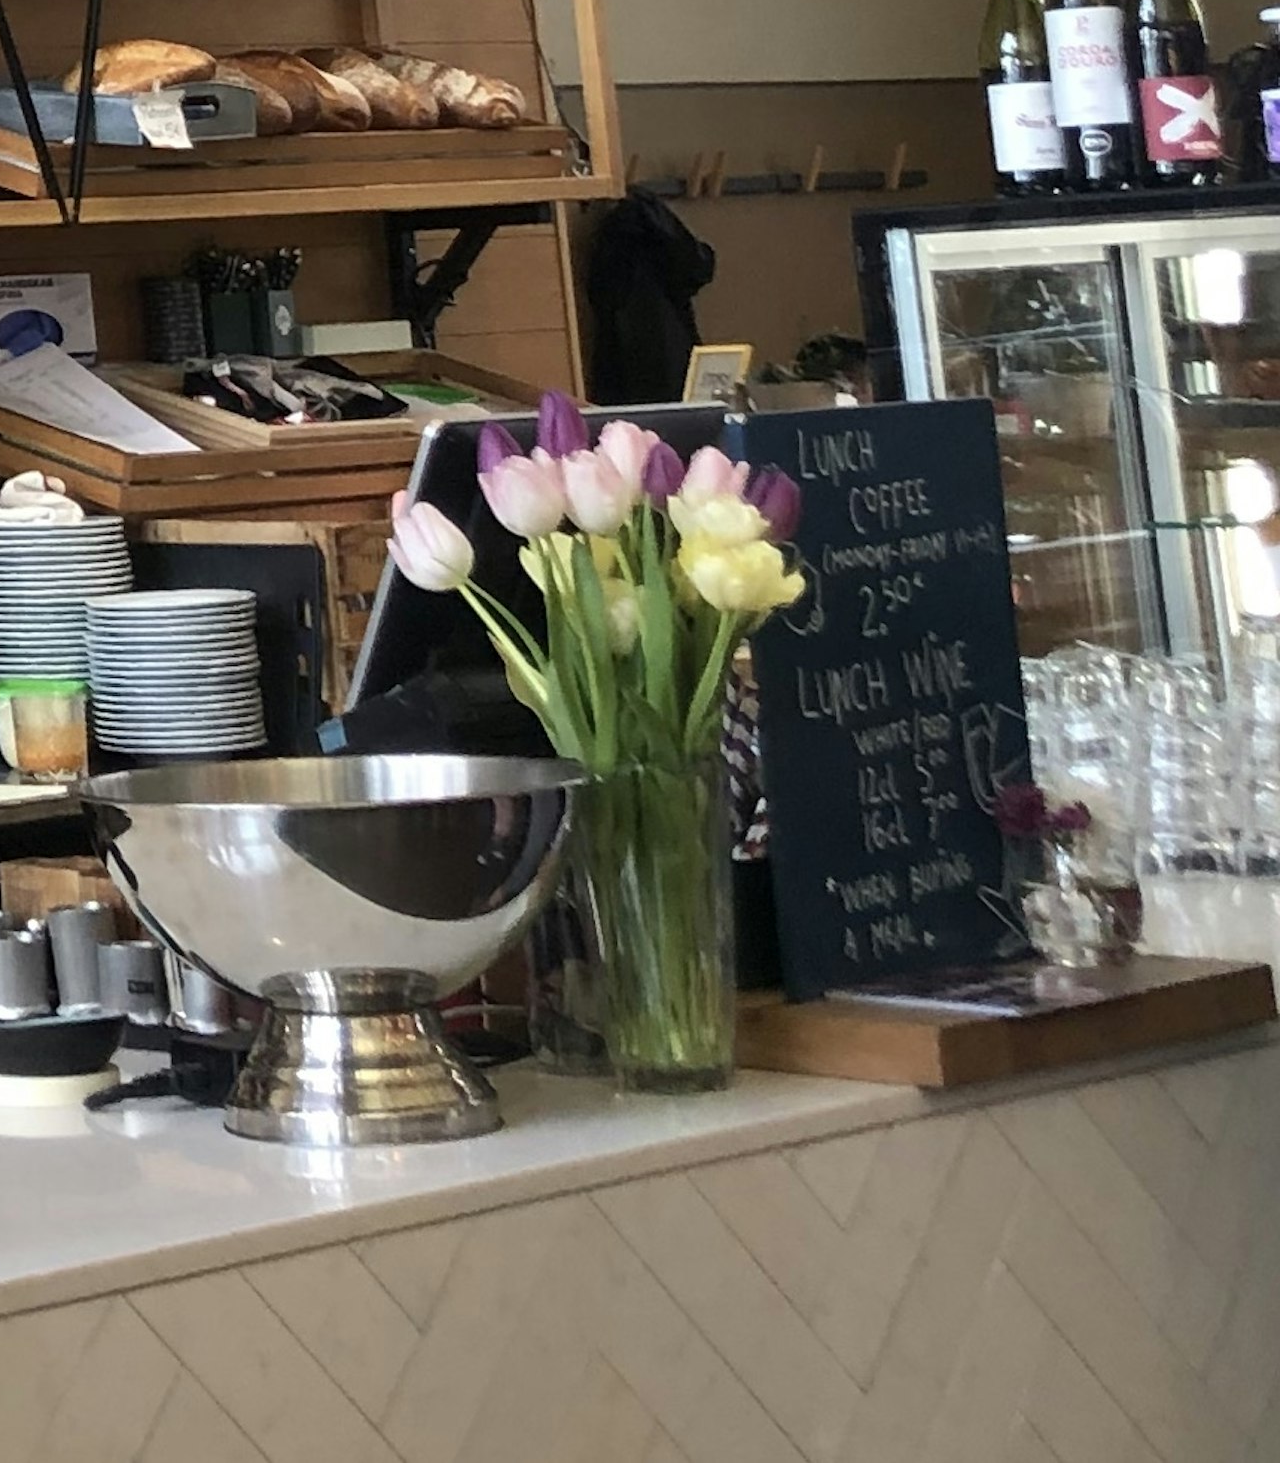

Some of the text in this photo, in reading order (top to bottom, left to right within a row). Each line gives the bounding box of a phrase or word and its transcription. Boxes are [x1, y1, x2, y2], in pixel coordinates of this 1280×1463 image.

[797, 429, 876, 487] LUNCH
[849, 477, 932, 534] COFFEE
[797, 630, 973, 725] LUNCH WINE
